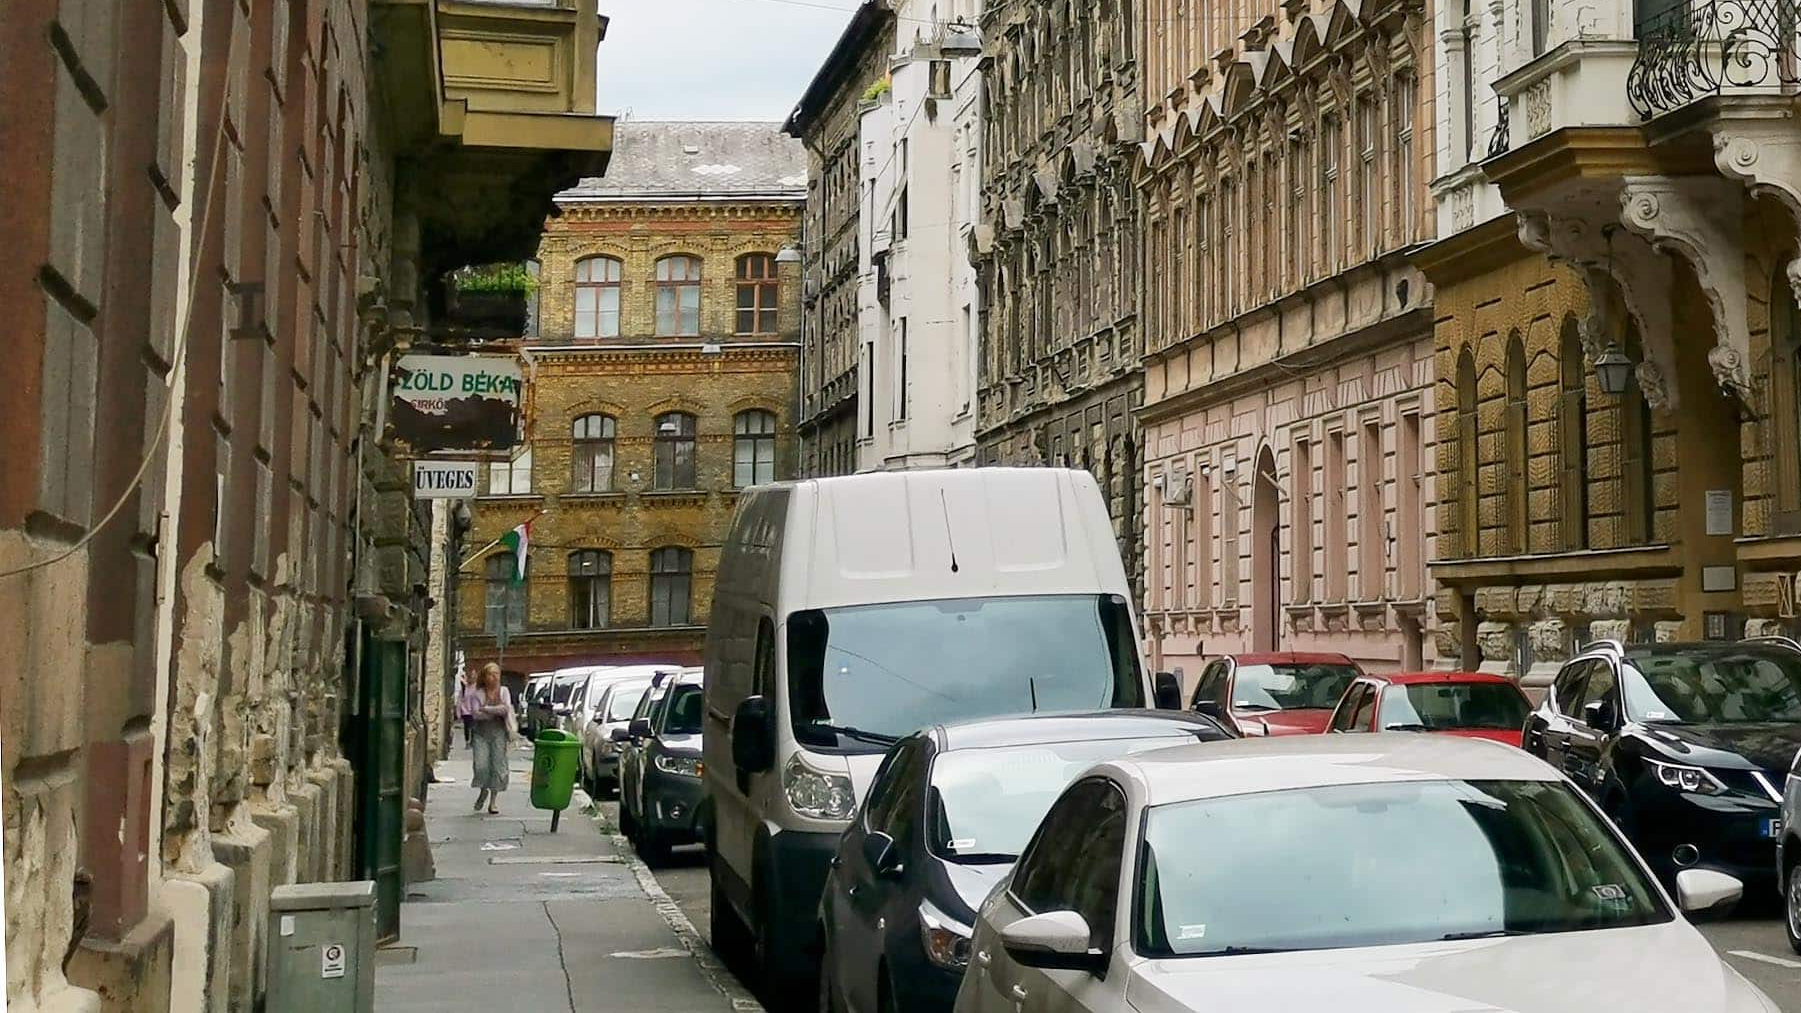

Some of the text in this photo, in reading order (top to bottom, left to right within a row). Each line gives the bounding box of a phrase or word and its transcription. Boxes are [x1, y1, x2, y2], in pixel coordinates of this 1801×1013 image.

[401, 368, 514, 394] ZÖLD BÉKA
[416, 465, 474, 489] ÜVEGES
